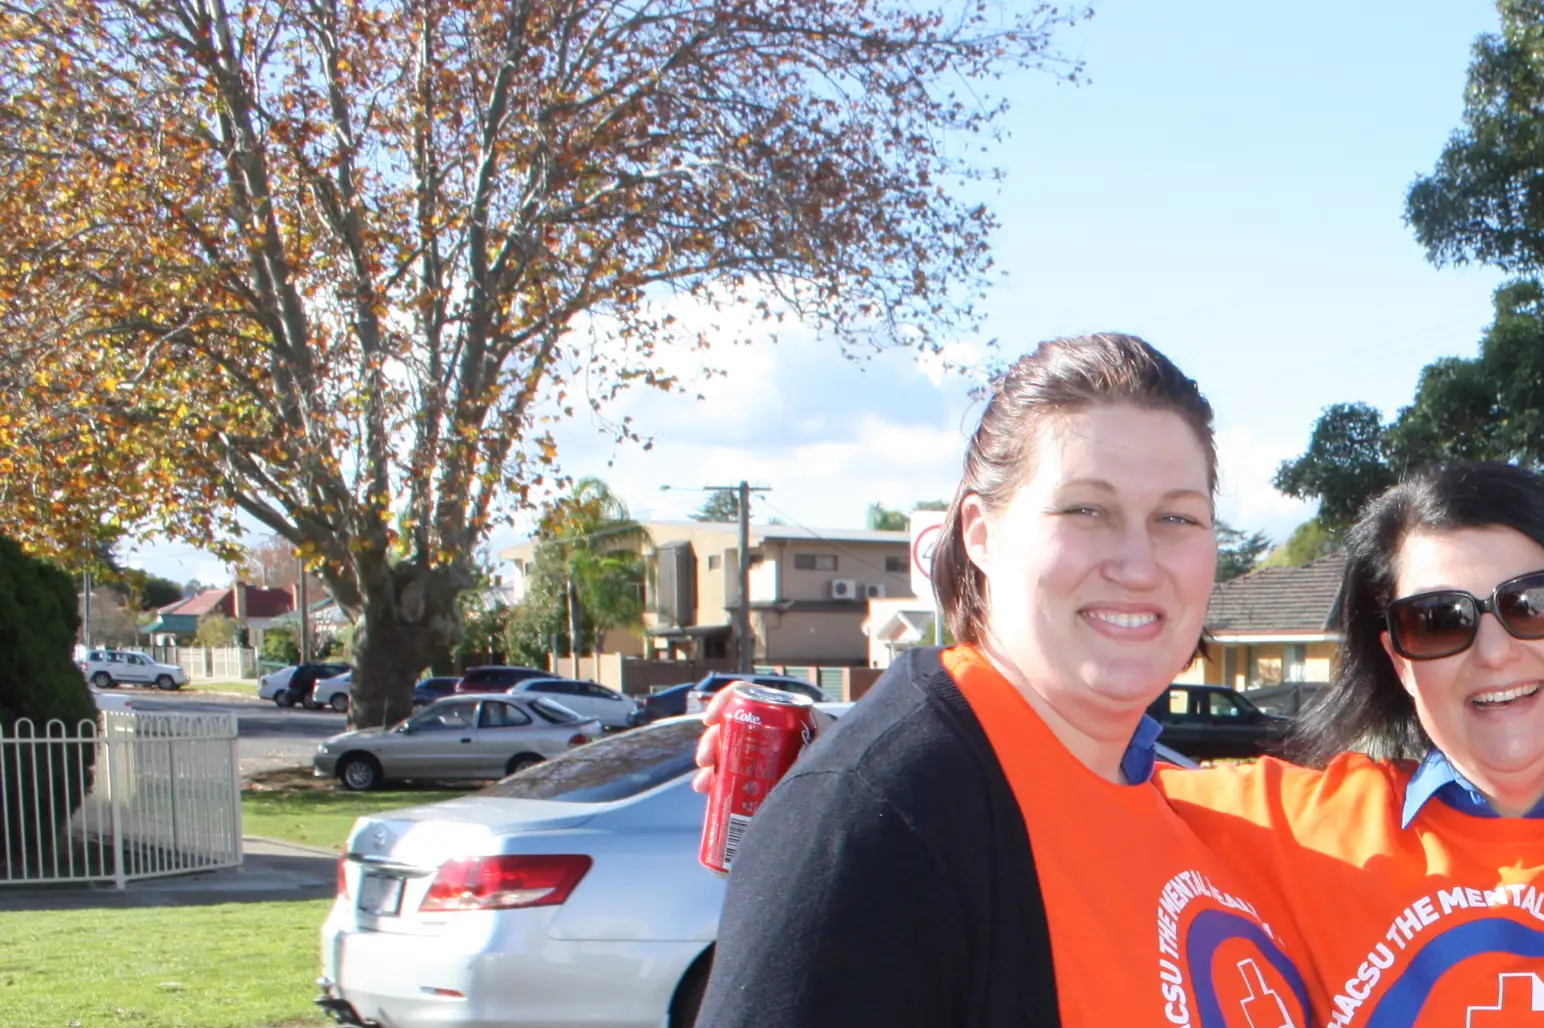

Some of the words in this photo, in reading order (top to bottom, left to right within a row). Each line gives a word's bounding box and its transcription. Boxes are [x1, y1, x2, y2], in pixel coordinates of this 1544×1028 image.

[734, 708, 762, 726] Coke
[1157, 906, 1180, 960] THE
[1385, 896, 1441, 951] THE
